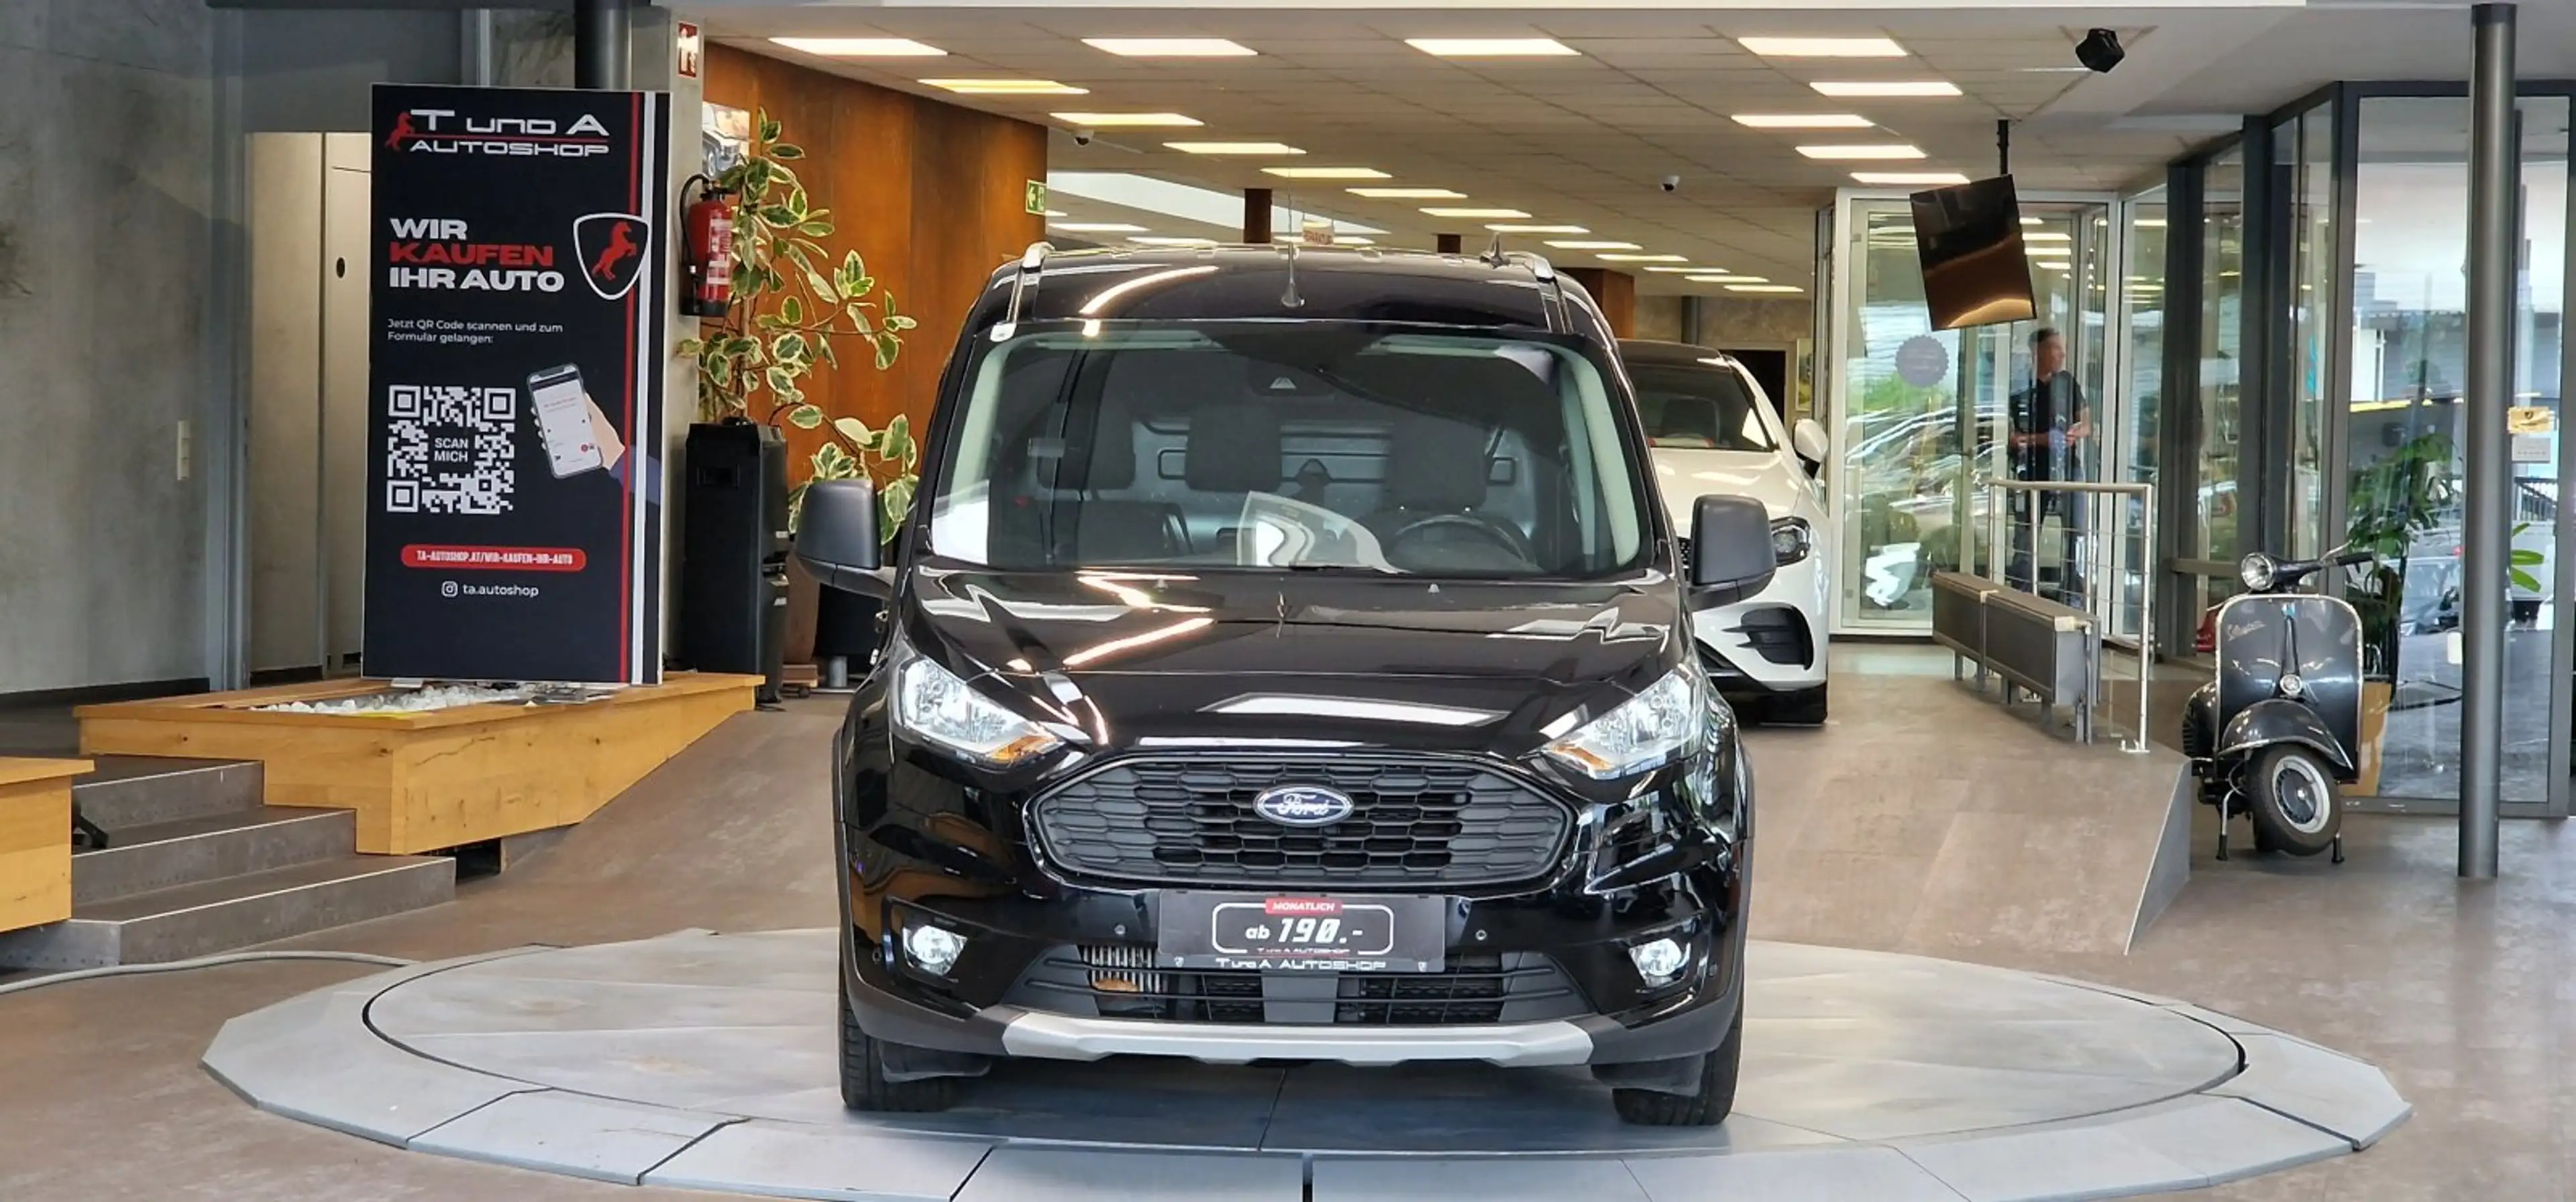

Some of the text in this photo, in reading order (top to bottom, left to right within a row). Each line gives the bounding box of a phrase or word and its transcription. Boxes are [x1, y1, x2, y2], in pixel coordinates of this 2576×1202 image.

[410, 109, 455, 131] T
[566, 114, 610, 136] A
[409, 140, 610, 157] AUTOSHOP
[389, 219, 468, 240] WIR
[389, 241, 553, 266] KAUFEN
[389, 268, 565, 292] IHR AUTO
[387, 319, 563, 333] Jetzt QR Code scannen und zum
[387, 331, 493, 344] Formular gelangen:
[434, 438, 469, 449] SCAN
[433, 451, 468, 463] MICH
[462, 584, 539, 598] ta.autoshop
[1277, 793, 1330, 816] Ford
[1273, 902, 1336, 912] MONATLICH
[1245, 924, 1271, 939] ab
[1279, 960, 1387, 971] AUTOSHOP
